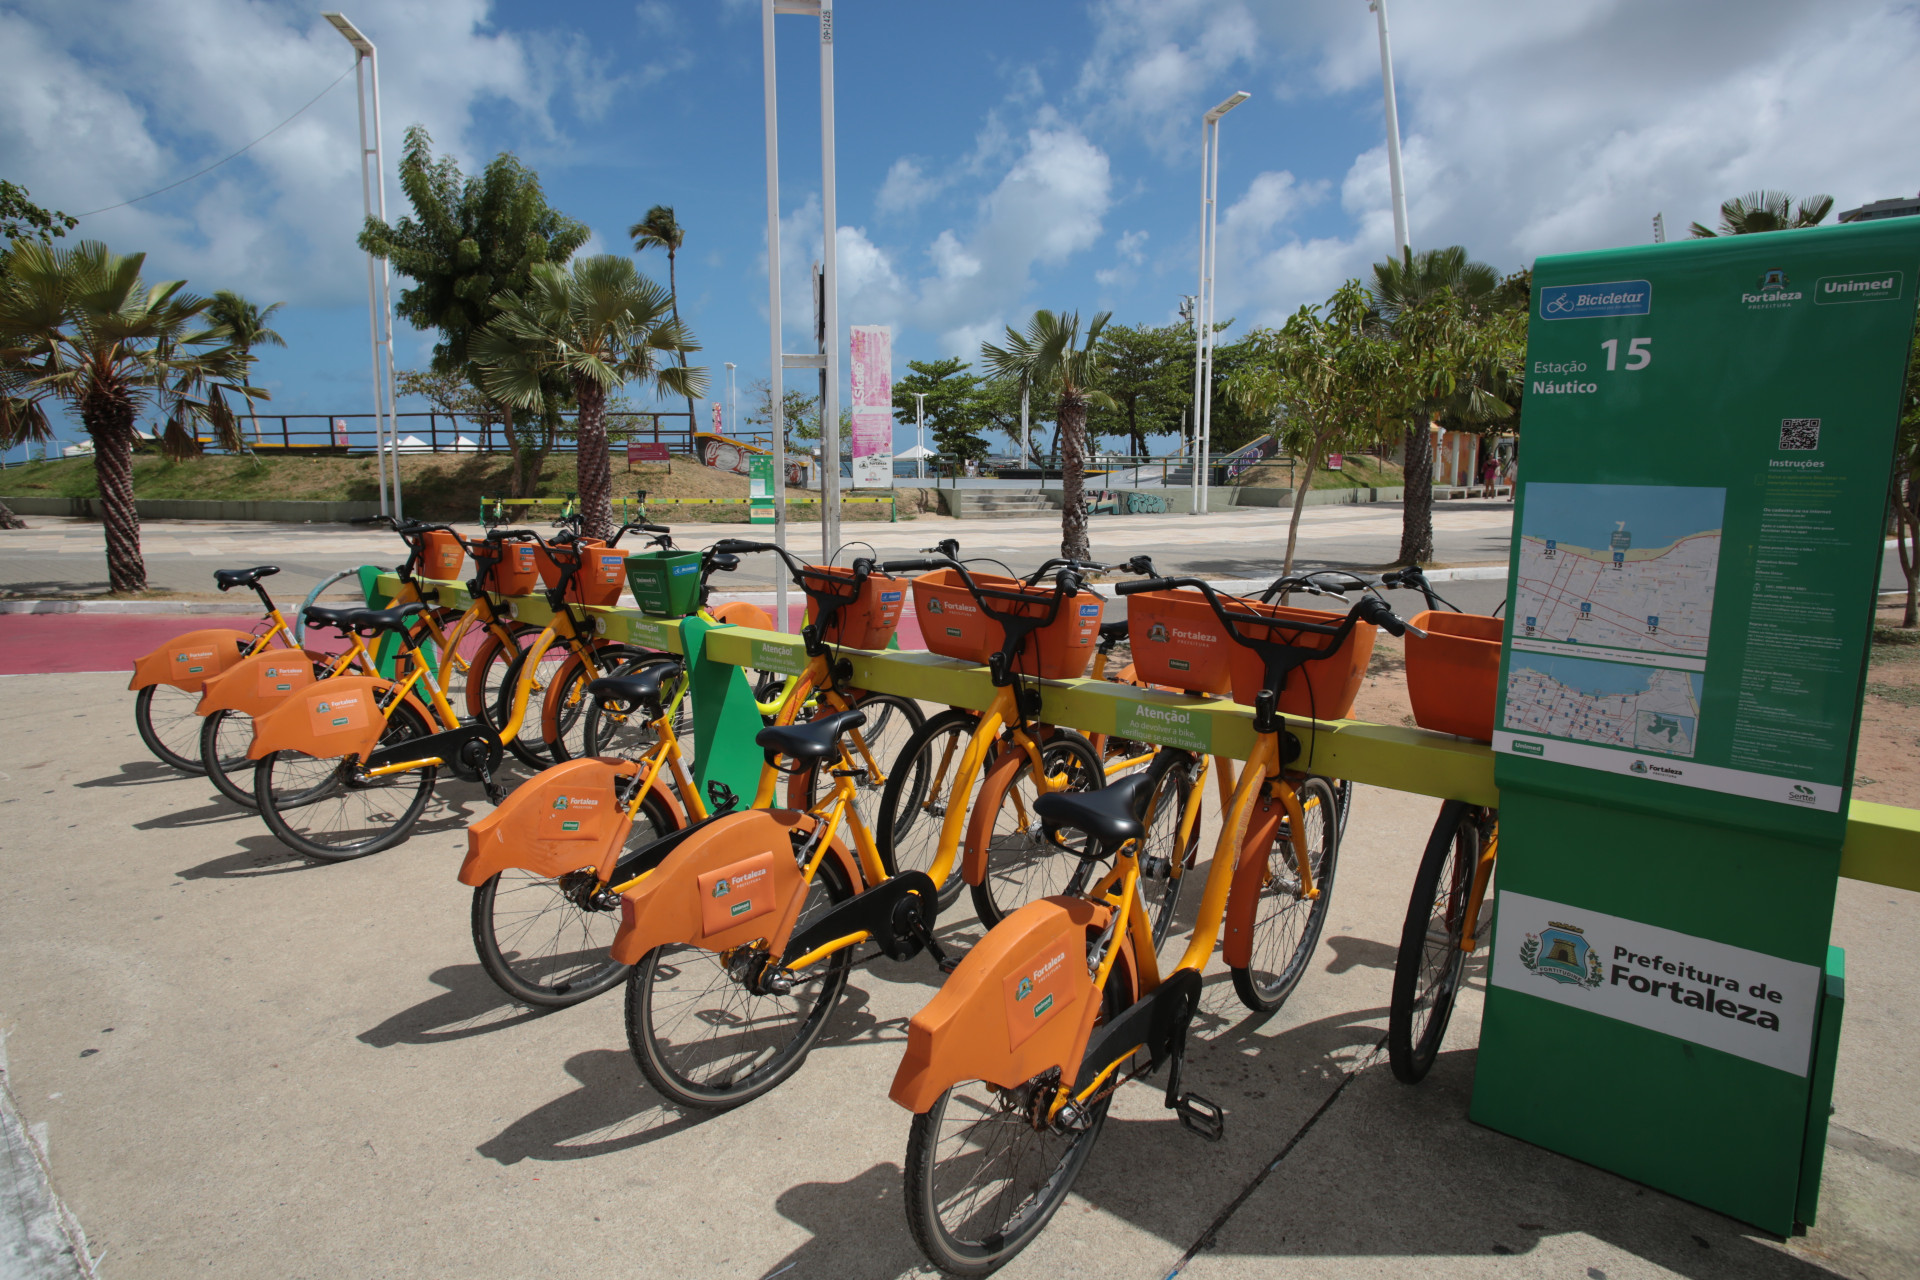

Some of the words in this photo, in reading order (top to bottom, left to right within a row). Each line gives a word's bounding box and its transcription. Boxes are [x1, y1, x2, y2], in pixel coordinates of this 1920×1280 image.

[823, 11, 831, 40] 09-12425
[1824, 277, 1894, 294] Unimed
[1576, 292, 1644, 306] Bicicletar
[1742, 290, 1802, 303] Fortaleza
[1534, 360, 1587, 375] Estação
[1601, 337, 1652, 371] 15
[1532, 380, 1597, 394] Náutico
[1769, 459, 1825, 469] Instruções
[944, 601, 977, 613] Fortaleza
[1172, 628, 1217, 642] Fortaleza
[762, 643, 793, 656] Atenção!
[1177, 639, 1209, 648] PREFEITURA
[1136, 704, 1191, 725] Atenção!
[1130, 720, 1139, 728] Ao
[1140, 720, 1171, 733] devolver
[1178, 727, 1196, 739] bike,
[1121, 728, 1152, 742] verifique
[1153, 734, 1161, 742] se
[1162, 734, 1177, 744] está
[1178, 737, 1207, 750] travada
[1650, 765, 1683, 776] Fortaleza
[570, 797, 599, 806] Fortaleza
[731, 868, 767, 885] Fortaleza
[732, 902, 750, 912] Unimed
[1033, 952, 1065, 980] Fortaleza
[1612, 945, 1739, 993] Prefeitura
[1748, 983, 1783, 1004] de
[1610, 964, 1780, 1032] Fortaleza
